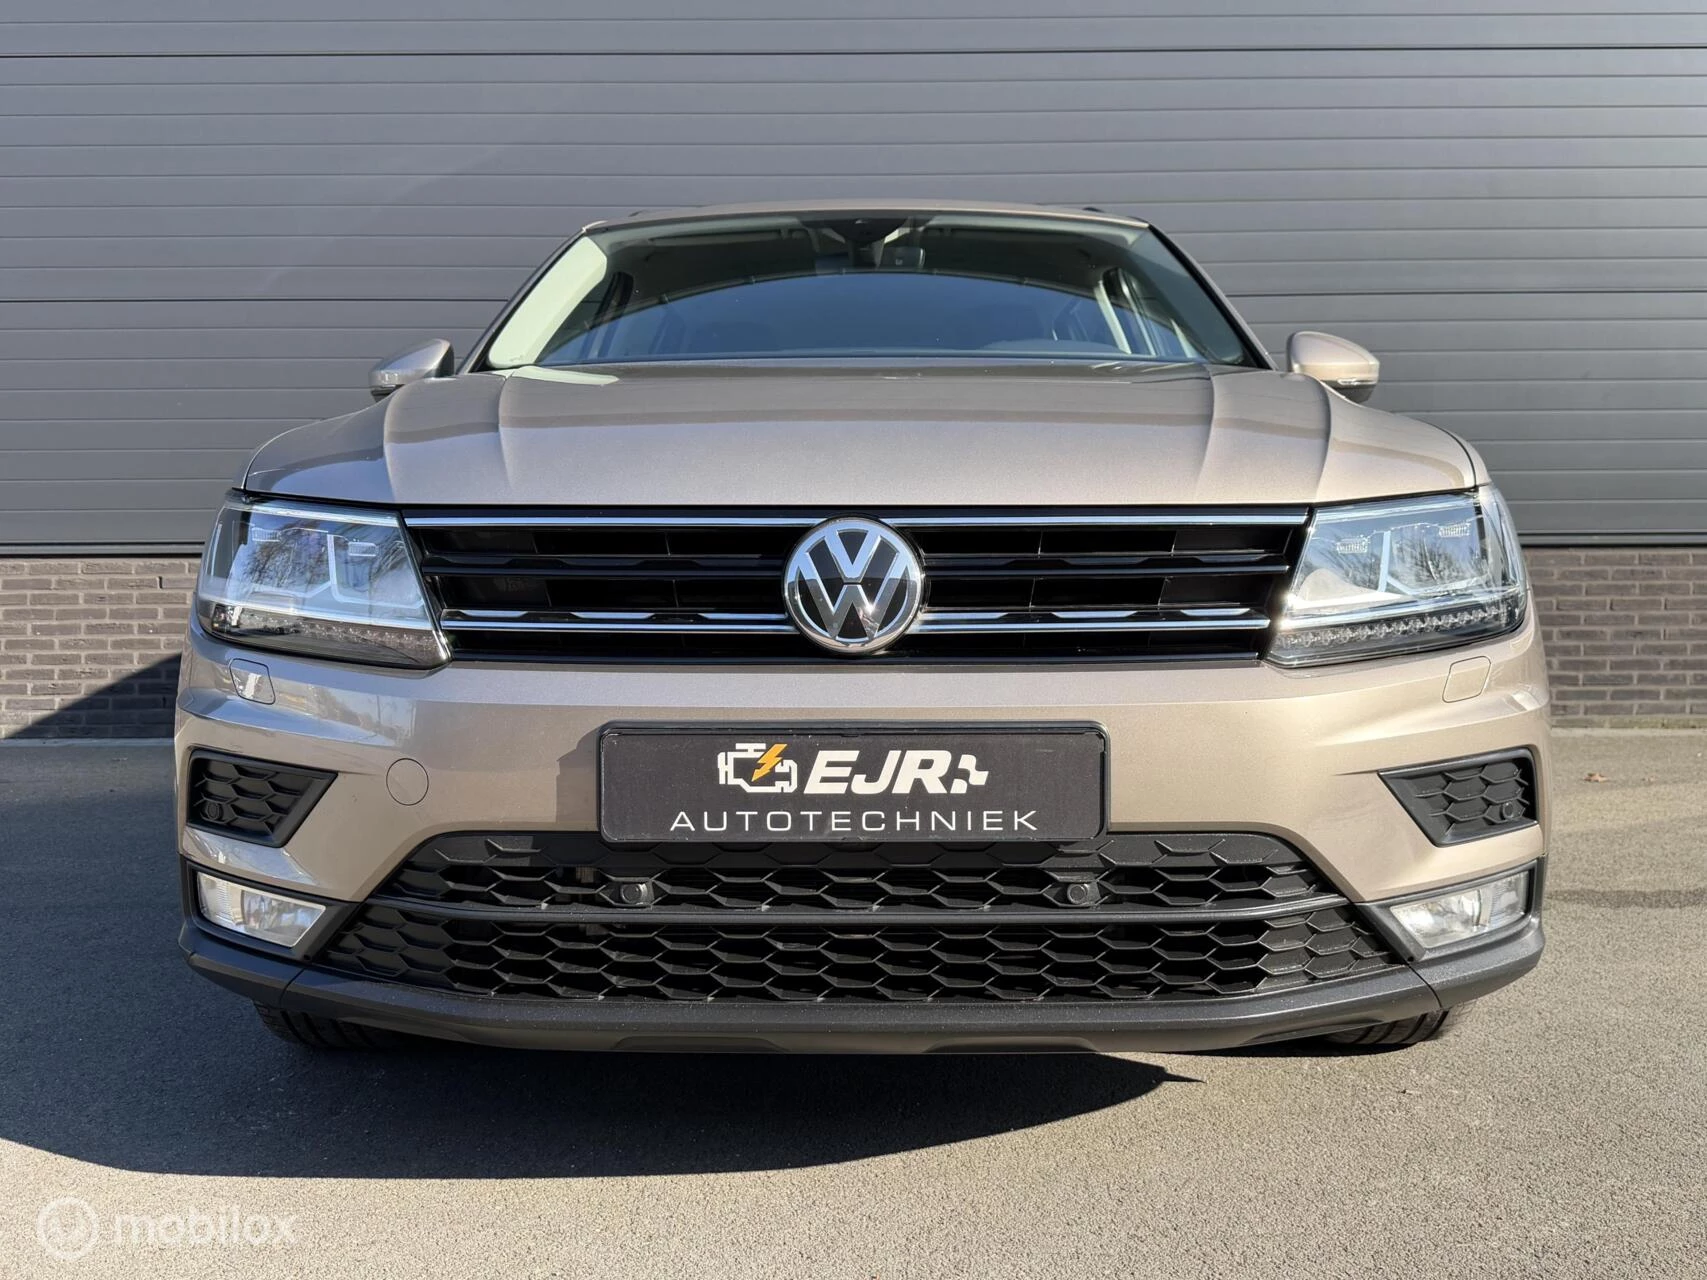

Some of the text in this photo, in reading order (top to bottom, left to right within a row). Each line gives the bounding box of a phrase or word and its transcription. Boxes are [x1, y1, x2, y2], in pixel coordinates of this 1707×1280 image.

[789, 519, 920, 650] VW
[803, 750, 952, 795] EJR
[669, 810, 1038, 832] AUTOTECHNIEK
